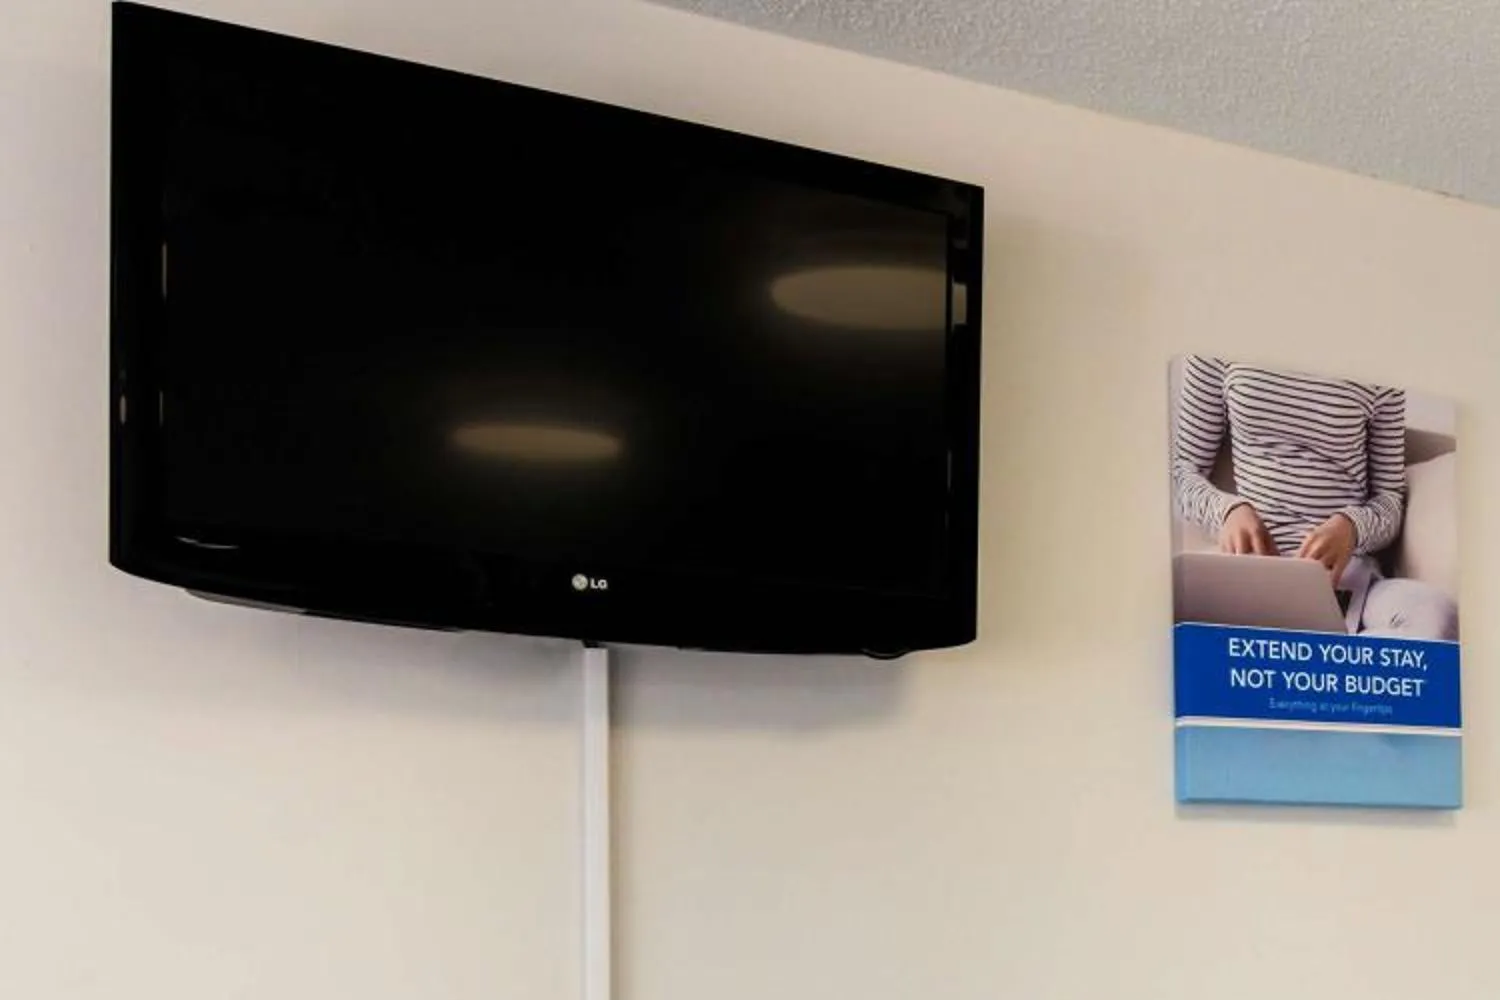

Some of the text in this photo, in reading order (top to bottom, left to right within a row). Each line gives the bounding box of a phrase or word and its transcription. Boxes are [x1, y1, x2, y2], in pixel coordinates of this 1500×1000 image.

[590, 578, 608, 589] LG
[1228, 637, 1428, 672] EXTEND YOUR STAY,
[1230, 668, 1425, 698] NOT YOUR BUDGET
